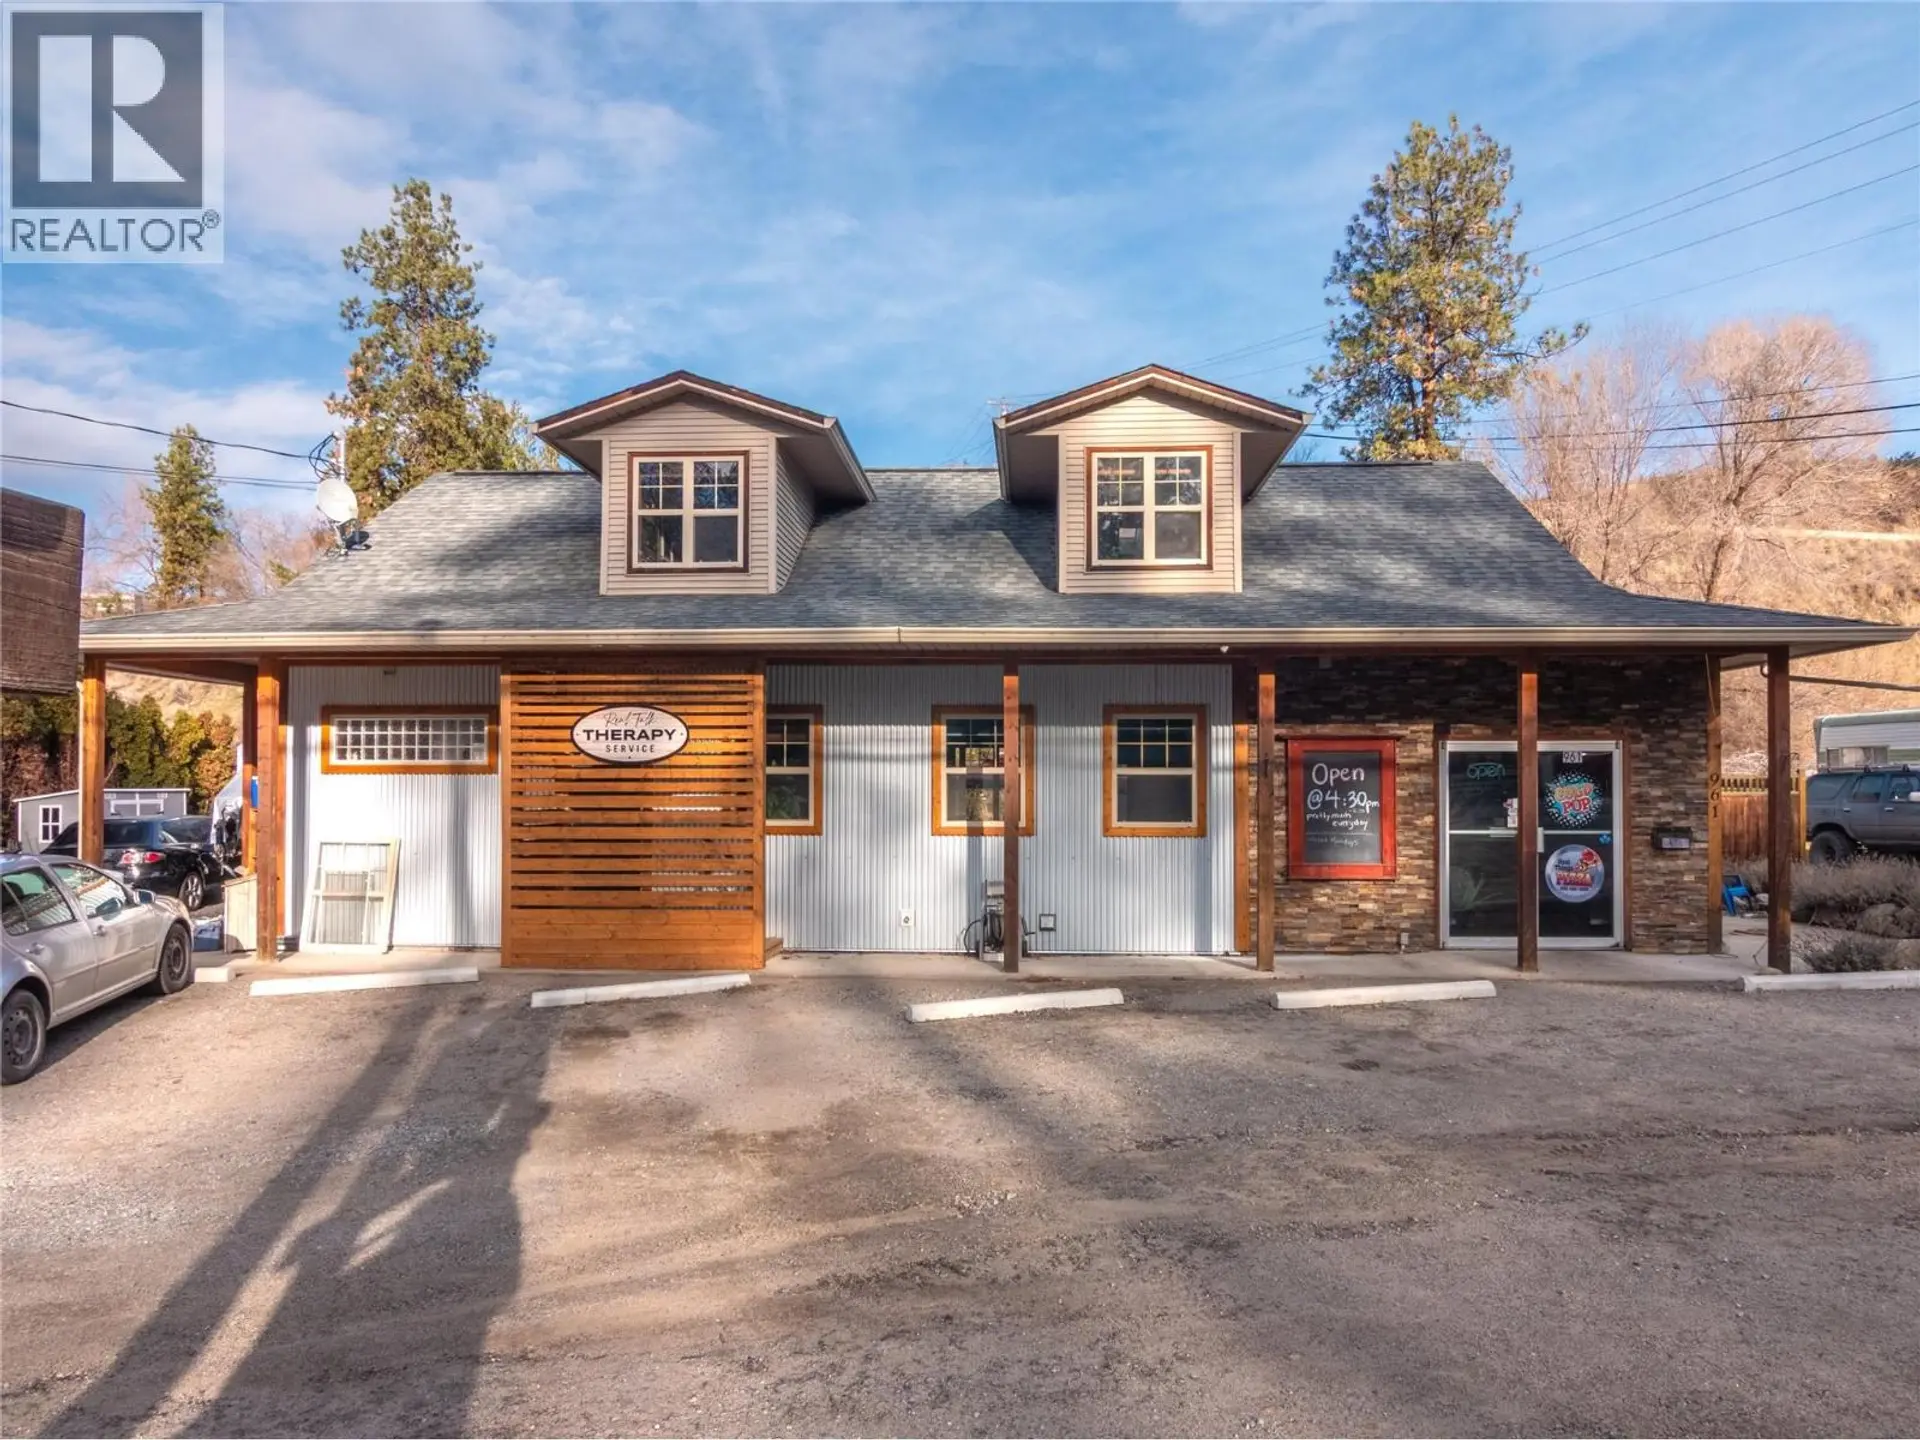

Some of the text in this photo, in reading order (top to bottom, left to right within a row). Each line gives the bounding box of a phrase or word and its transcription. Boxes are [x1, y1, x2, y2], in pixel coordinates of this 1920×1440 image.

[603, 711, 657, 727] Real Talk
[583, 729, 676, 741] THERAPY
[605, 744, 655, 753] SERVICE
[1312, 763, 1365, 786] Open
[1306, 811, 1330, 822] pretty
[1331, 819, 1369, 831] everyday
